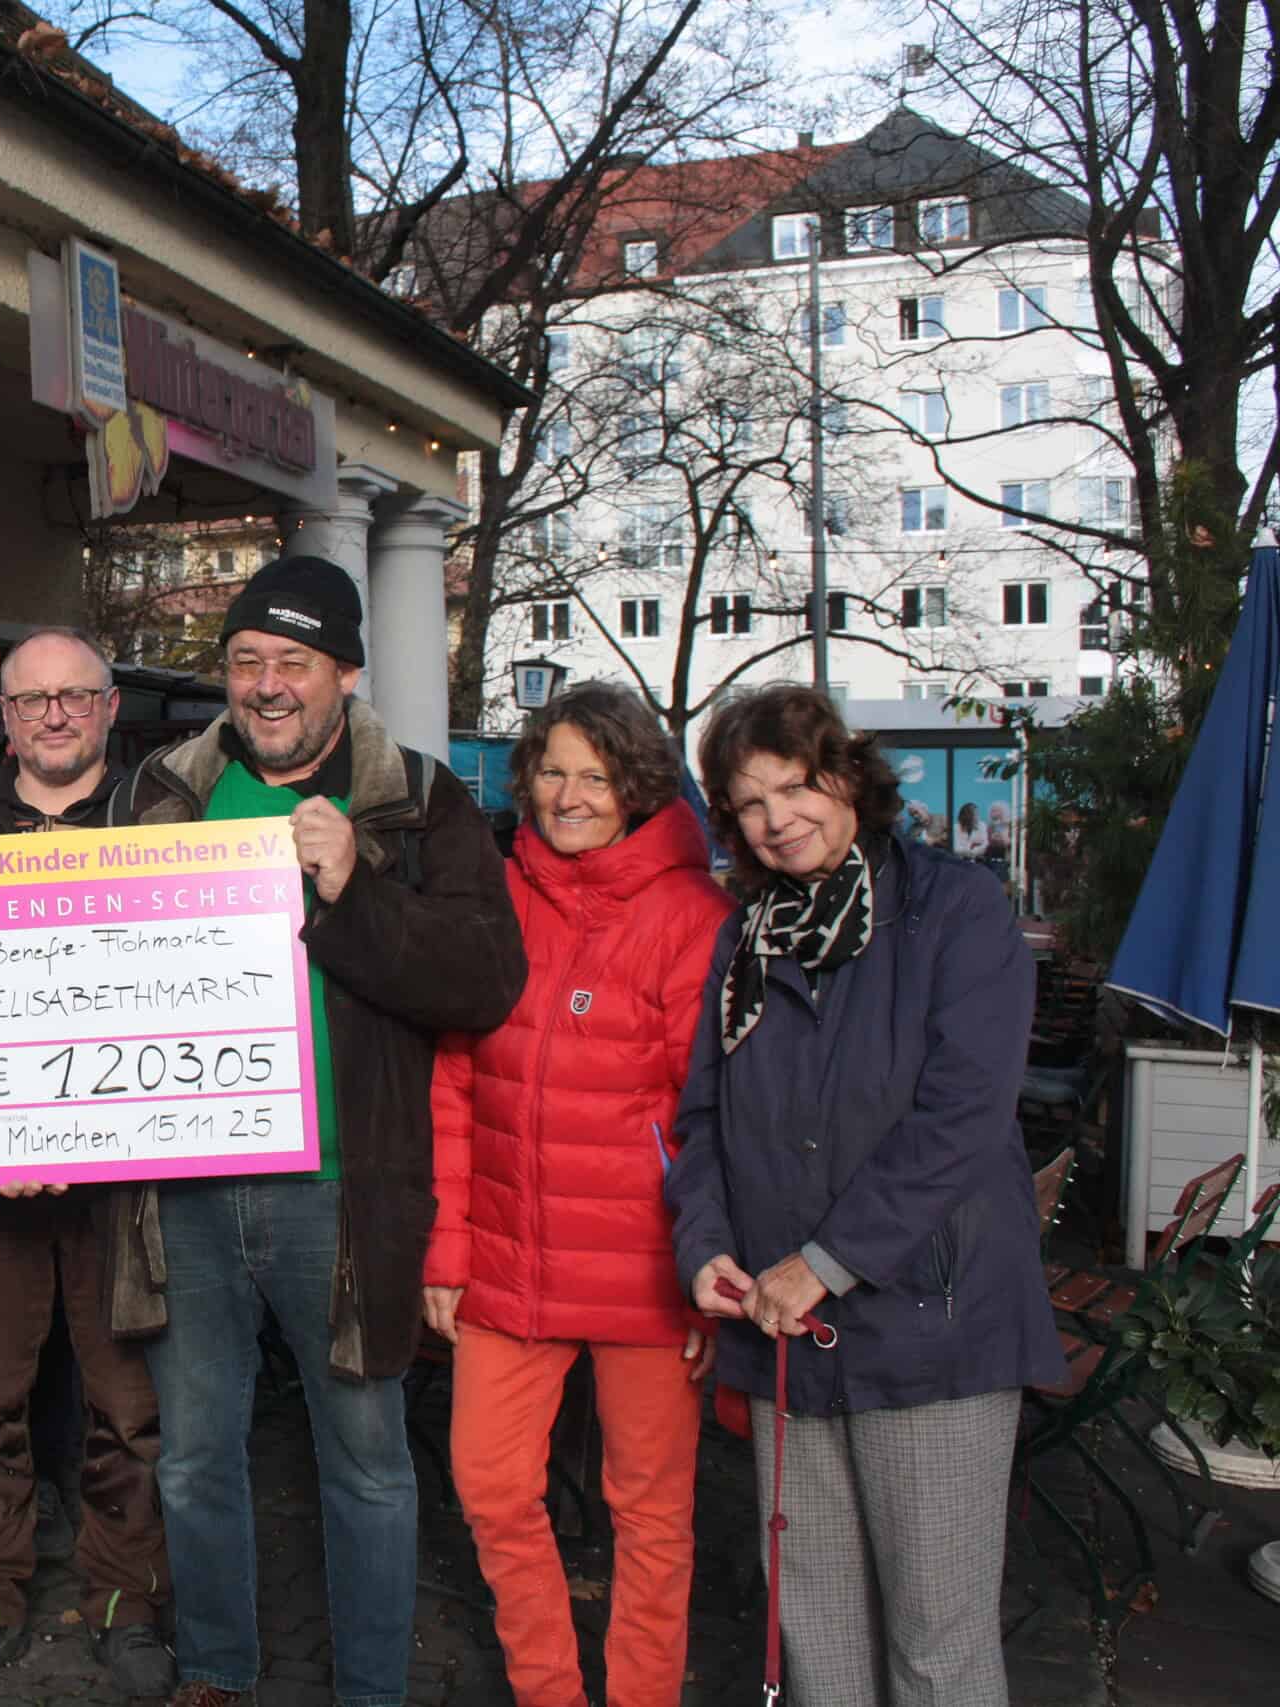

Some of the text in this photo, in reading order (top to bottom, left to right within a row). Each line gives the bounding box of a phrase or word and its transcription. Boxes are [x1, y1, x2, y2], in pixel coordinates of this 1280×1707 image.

[97, 839, 228, 868] München
[236, 833, 286, 860] e.V.
[91, 925, 235, 958] Flohmarkt
